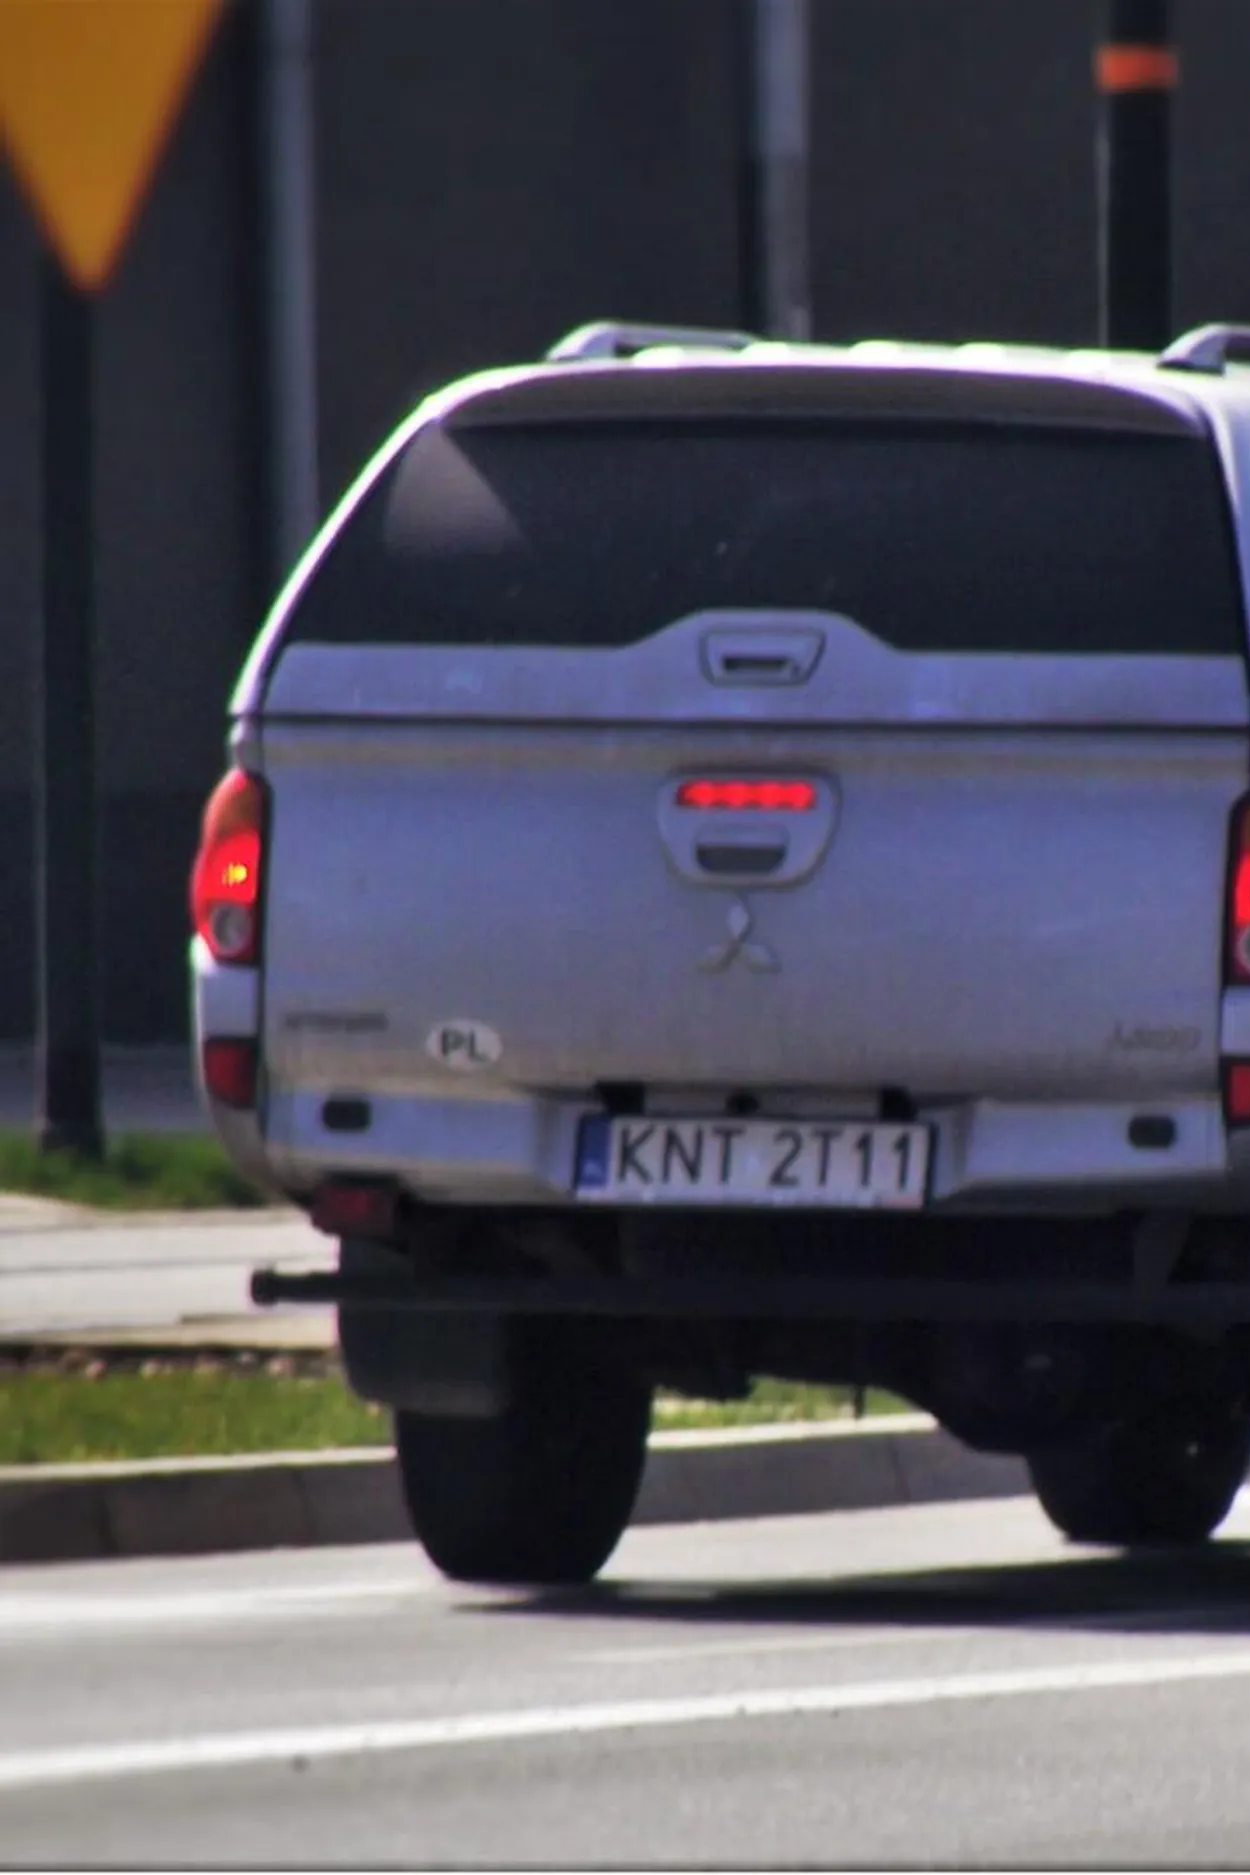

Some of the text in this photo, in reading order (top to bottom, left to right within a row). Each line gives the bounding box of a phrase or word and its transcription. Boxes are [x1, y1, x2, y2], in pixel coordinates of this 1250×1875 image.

[441, 1028, 491, 1063] PL
[617, 1124, 744, 1186] KNT
[769, 1128, 913, 1190] 2T11
